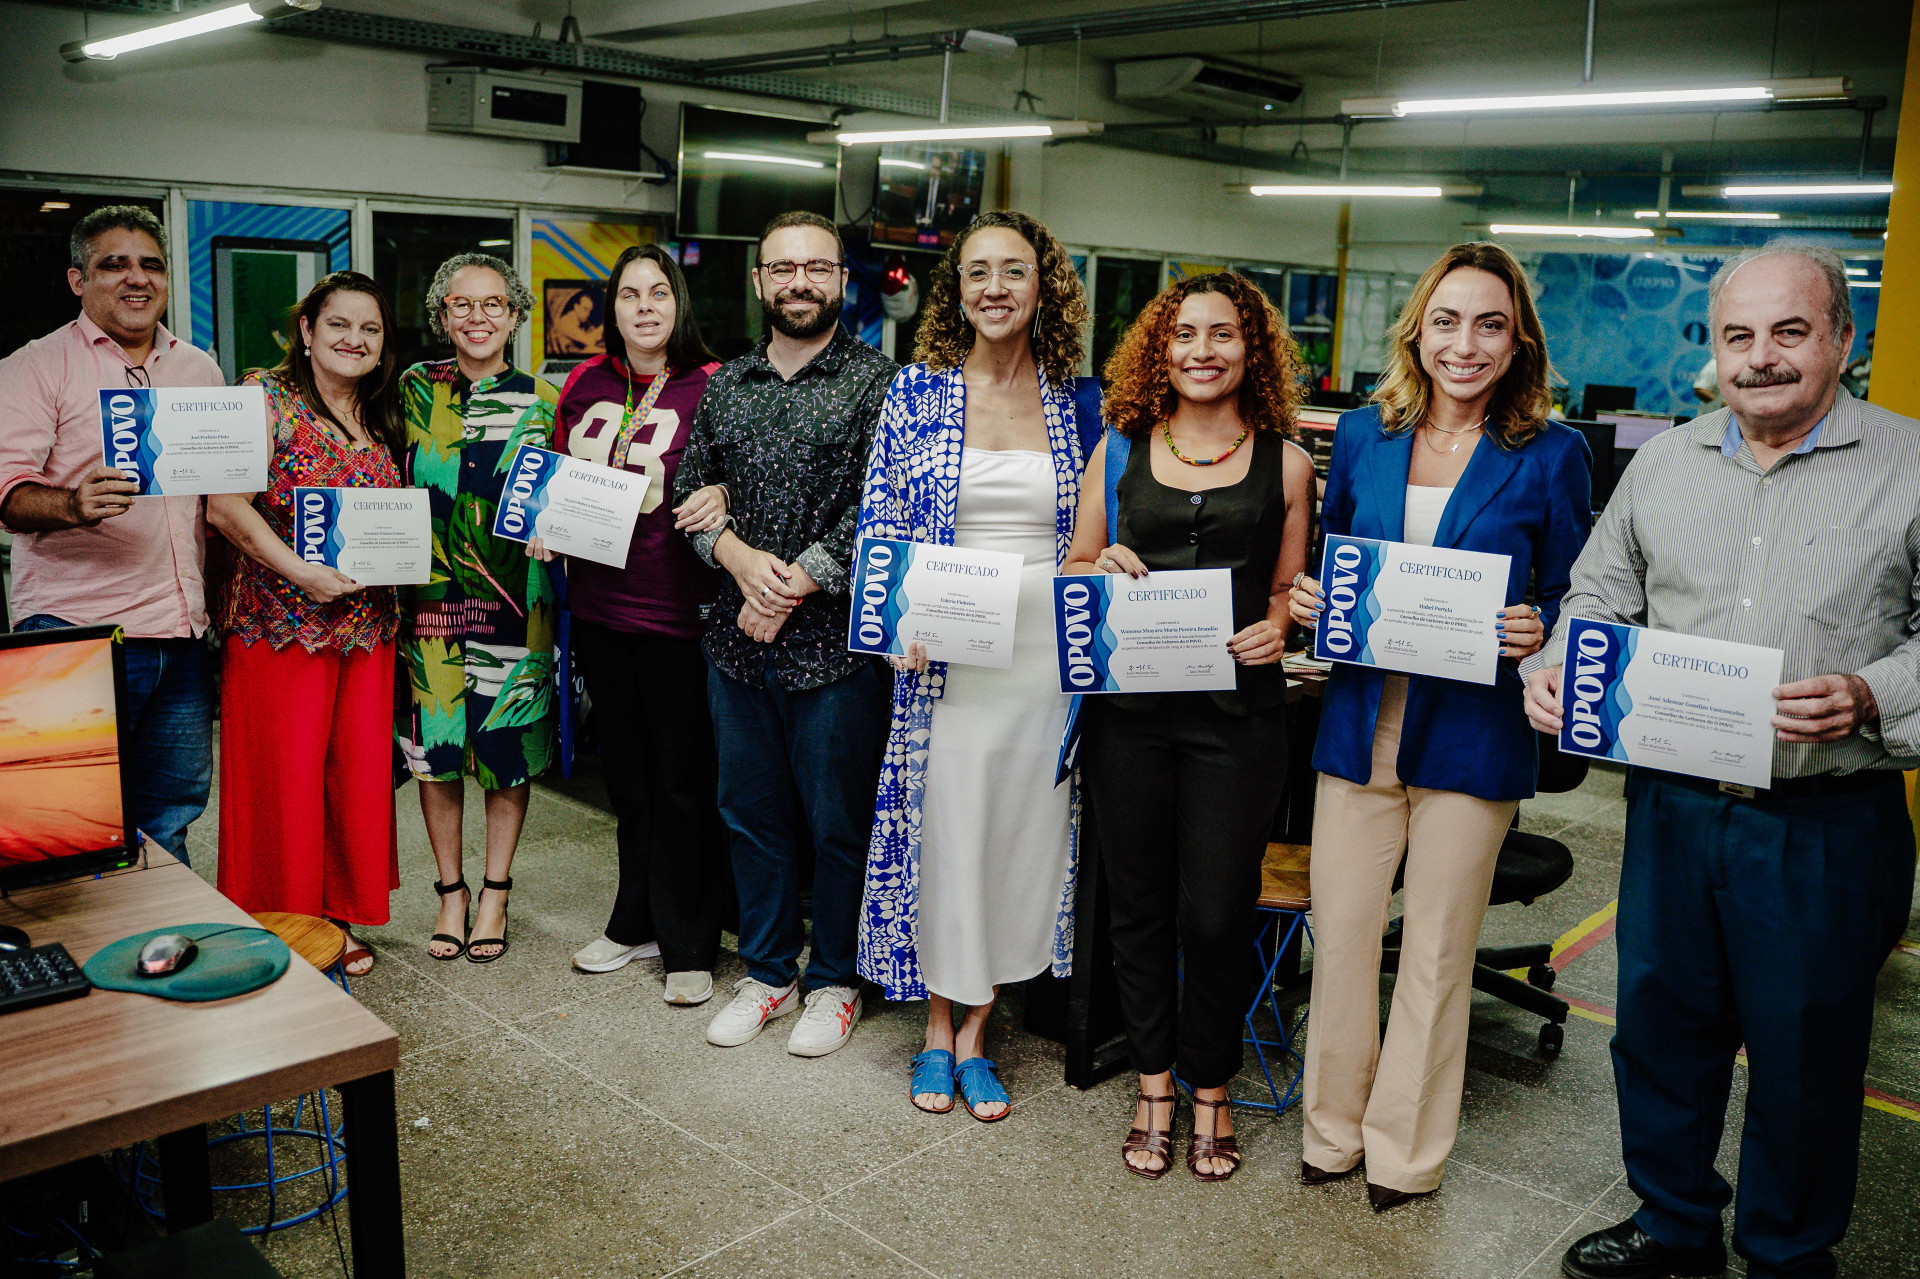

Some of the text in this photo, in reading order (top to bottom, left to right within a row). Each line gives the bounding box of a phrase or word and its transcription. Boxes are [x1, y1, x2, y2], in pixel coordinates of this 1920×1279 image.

[171, 401, 243, 412] CERTIFICADO
[503, 452, 544, 534] OPOVO
[569, 470, 628, 492] CERTIFICADO
[353, 501, 413, 511] CERTIFICADO
[303, 493, 326, 566] POVO
[926, 560, 999, 578] CERTIFICADO
[1399, 561, 1482, 582] CERTIFICADO
[858, 545, 893, 646] OPOVO
[1128, 588, 1207, 602] CERTIFICADO
[1326, 544, 1361, 654] OPOVO
[1063, 583, 1095, 687] OPOVO
[1652, 652, 1749, 680] CERTIFICADO
[1571, 629, 1609, 748] OPOVO
[1708, 706, 1745, 717] Vasconcelos
